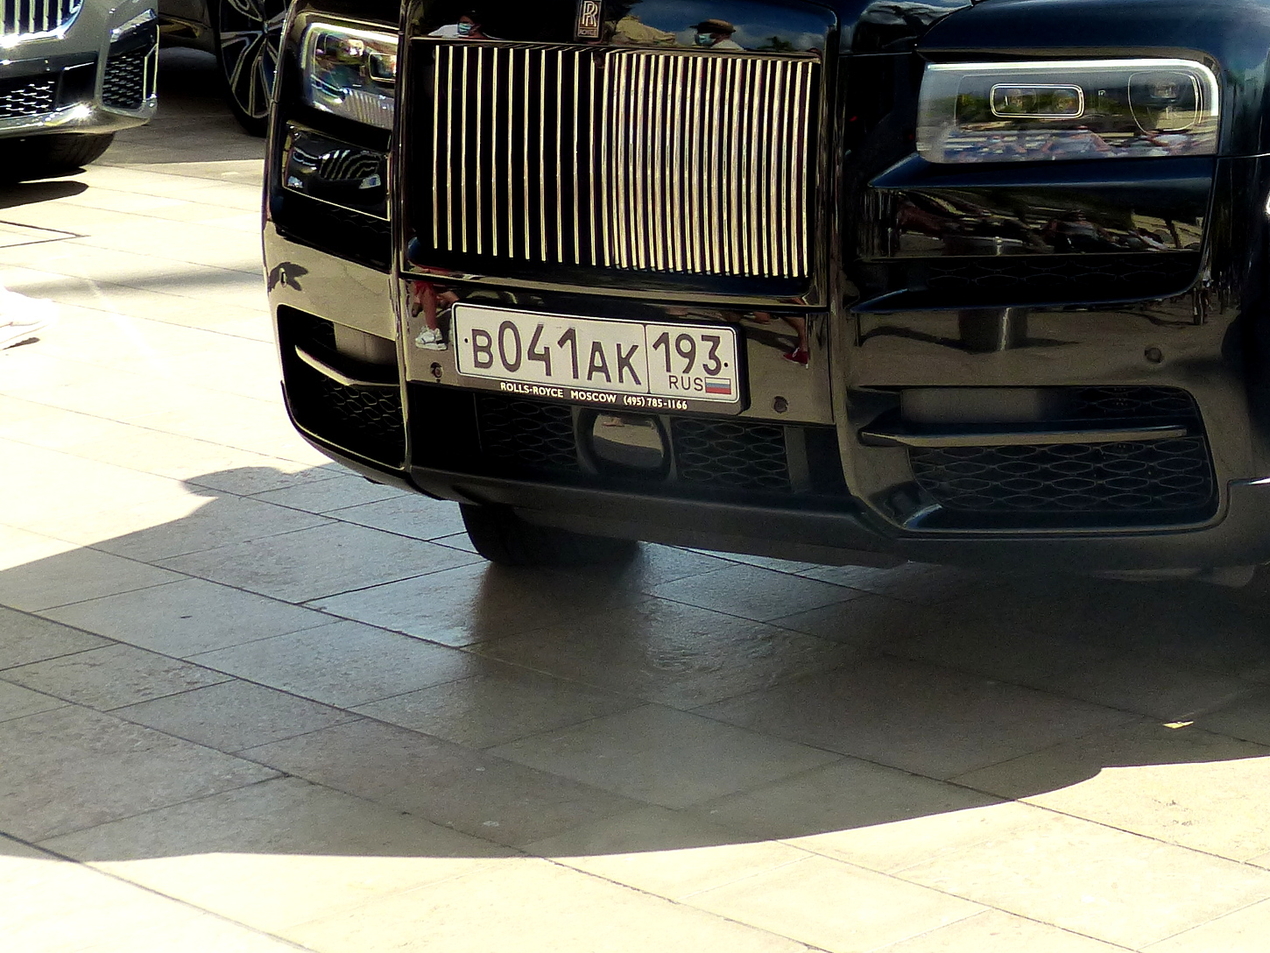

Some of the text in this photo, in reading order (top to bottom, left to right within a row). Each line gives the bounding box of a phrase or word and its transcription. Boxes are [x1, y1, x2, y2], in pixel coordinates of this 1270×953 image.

[652, 331, 722, 376] 193
[500, 382, 564, 398] ROLLS-ROYCE
[570, 390, 617, 404] MOSCOW
[623, 396, 645, 407] (495)
[668, 375, 704, 392] RUS
